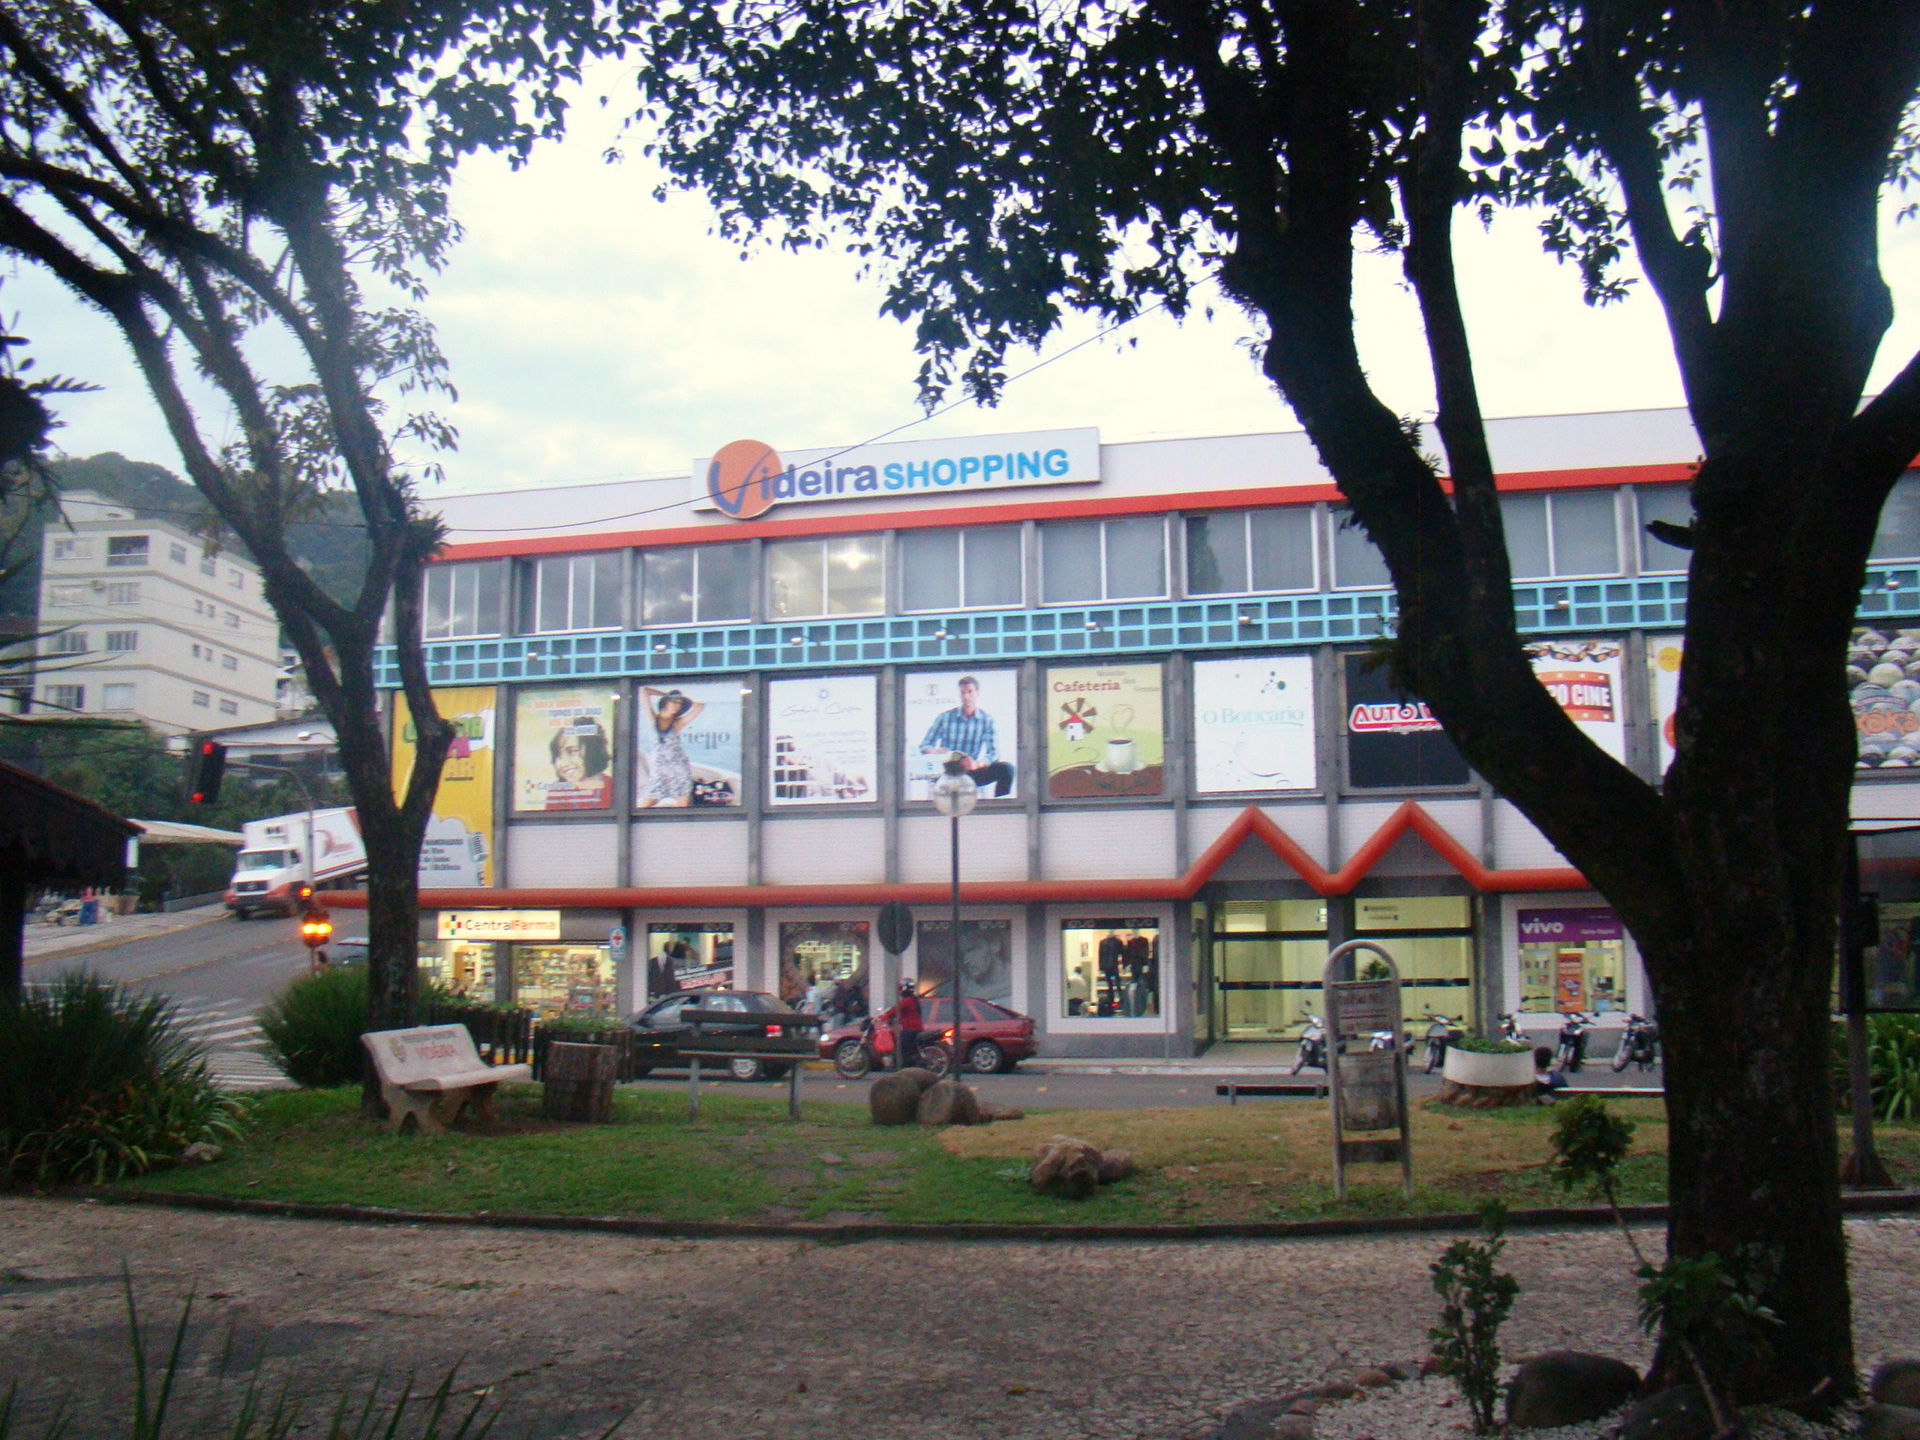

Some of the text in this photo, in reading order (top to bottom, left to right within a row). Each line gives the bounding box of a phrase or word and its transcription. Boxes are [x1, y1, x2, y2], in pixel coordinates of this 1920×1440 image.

[709, 448, 1070, 513] Videira SHOPPING
[1053, 681, 1121, 693] Cafeteria
[1571, 684, 1612, 707] CINE
[1521, 917, 1564, 934] vivo
